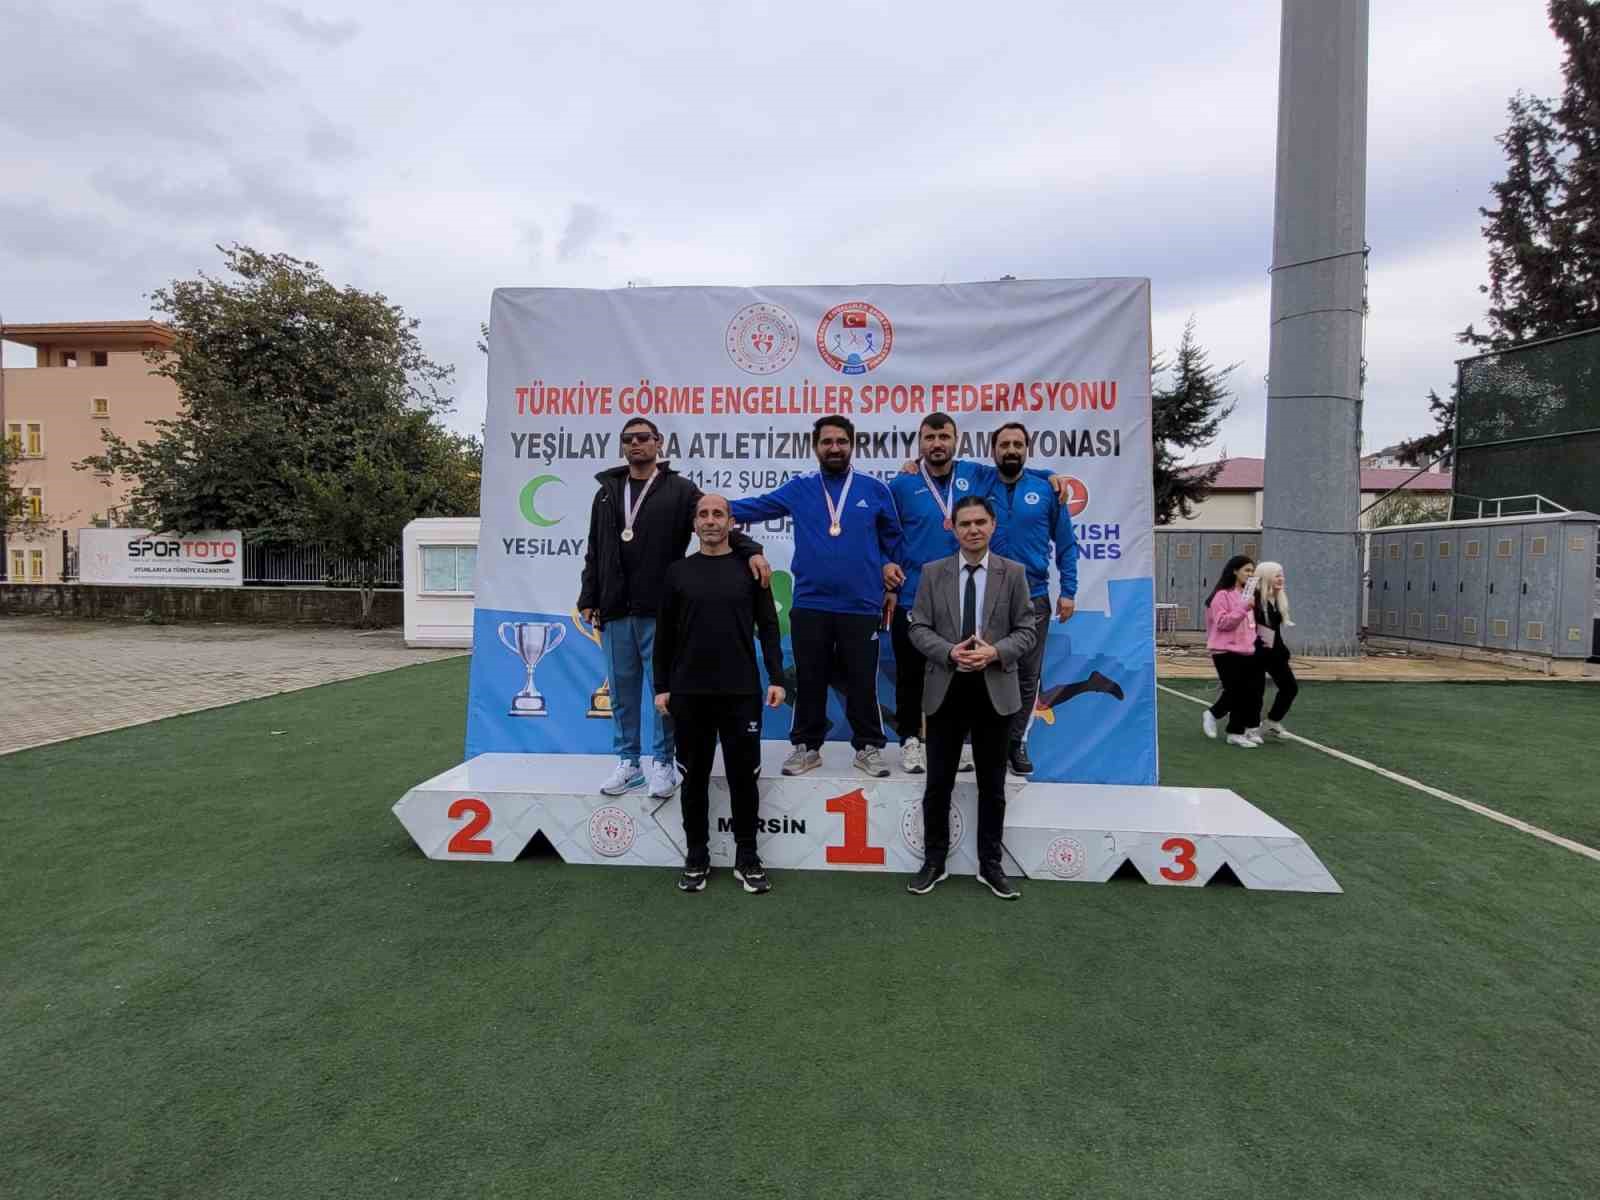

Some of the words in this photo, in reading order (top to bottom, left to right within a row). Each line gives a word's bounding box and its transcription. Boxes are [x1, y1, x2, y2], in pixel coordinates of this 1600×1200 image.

[514, 380, 612, 416] TÜRKİYE
[619, 379, 705, 415] GÖRME
[711, 380, 853, 415] ENGELLİLER
[860, 384, 924, 414] SPOR
[931, 381, 1118, 413] FEDERASYONU
[510, 427, 611, 465] YEŞİLAY
[688, 427, 811, 459] ATLETİZM
[958, 429, 1121, 458] AMYONASI
[687, 470, 732, 490] 11-12
[447, 798, 493, 854] 2
[718, 815, 806, 834] MRSİN
[825, 787, 886, 865] 1
[1159, 837, 1197, 882] 3
